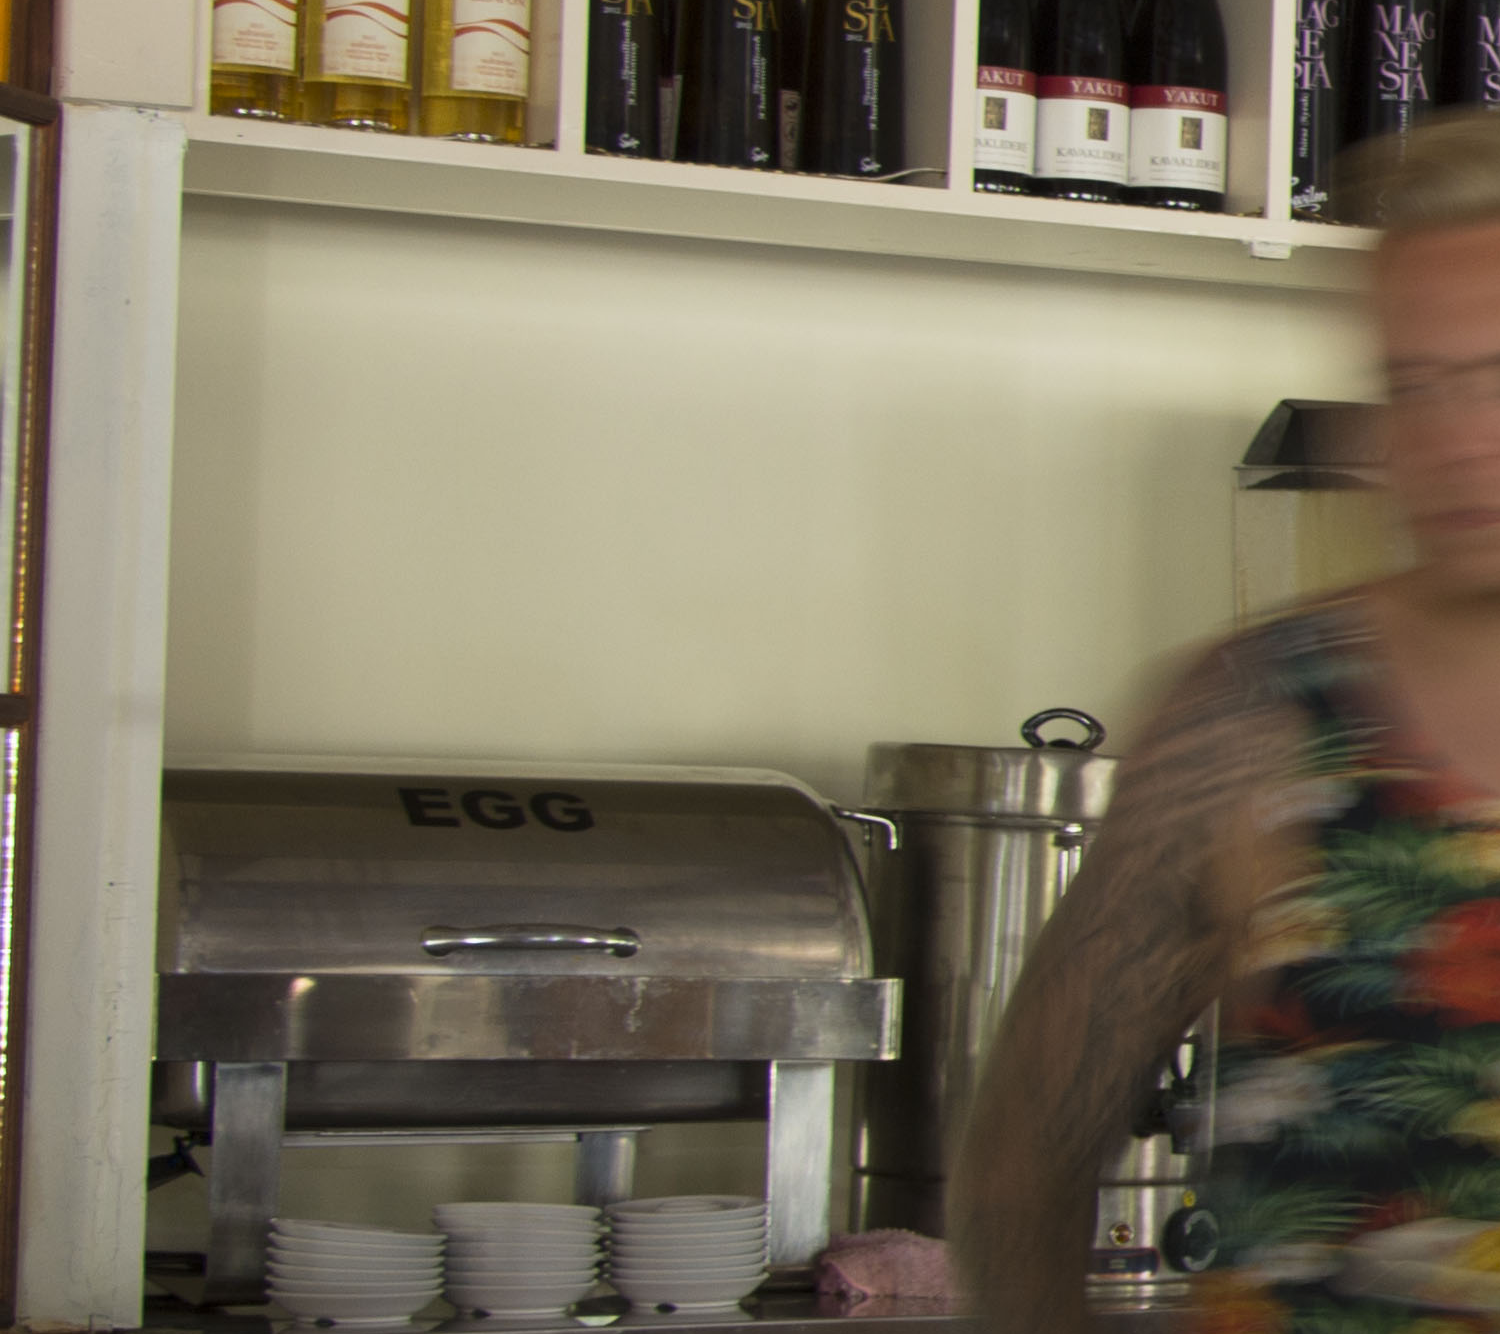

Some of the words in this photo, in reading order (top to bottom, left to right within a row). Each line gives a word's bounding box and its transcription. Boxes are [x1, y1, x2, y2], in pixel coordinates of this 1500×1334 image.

[1375, 4, 1436, 42] MAG
[1375, 29, 1422, 71] NE
[980, 70, 1025, 87] AKUT
[1071, 79, 1124, 98] YAKUT
[1378, 61, 1430, 100] SIA
[1164, 89, 1219, 107] YAKUT
[397, 787, 596, 832] EGG
